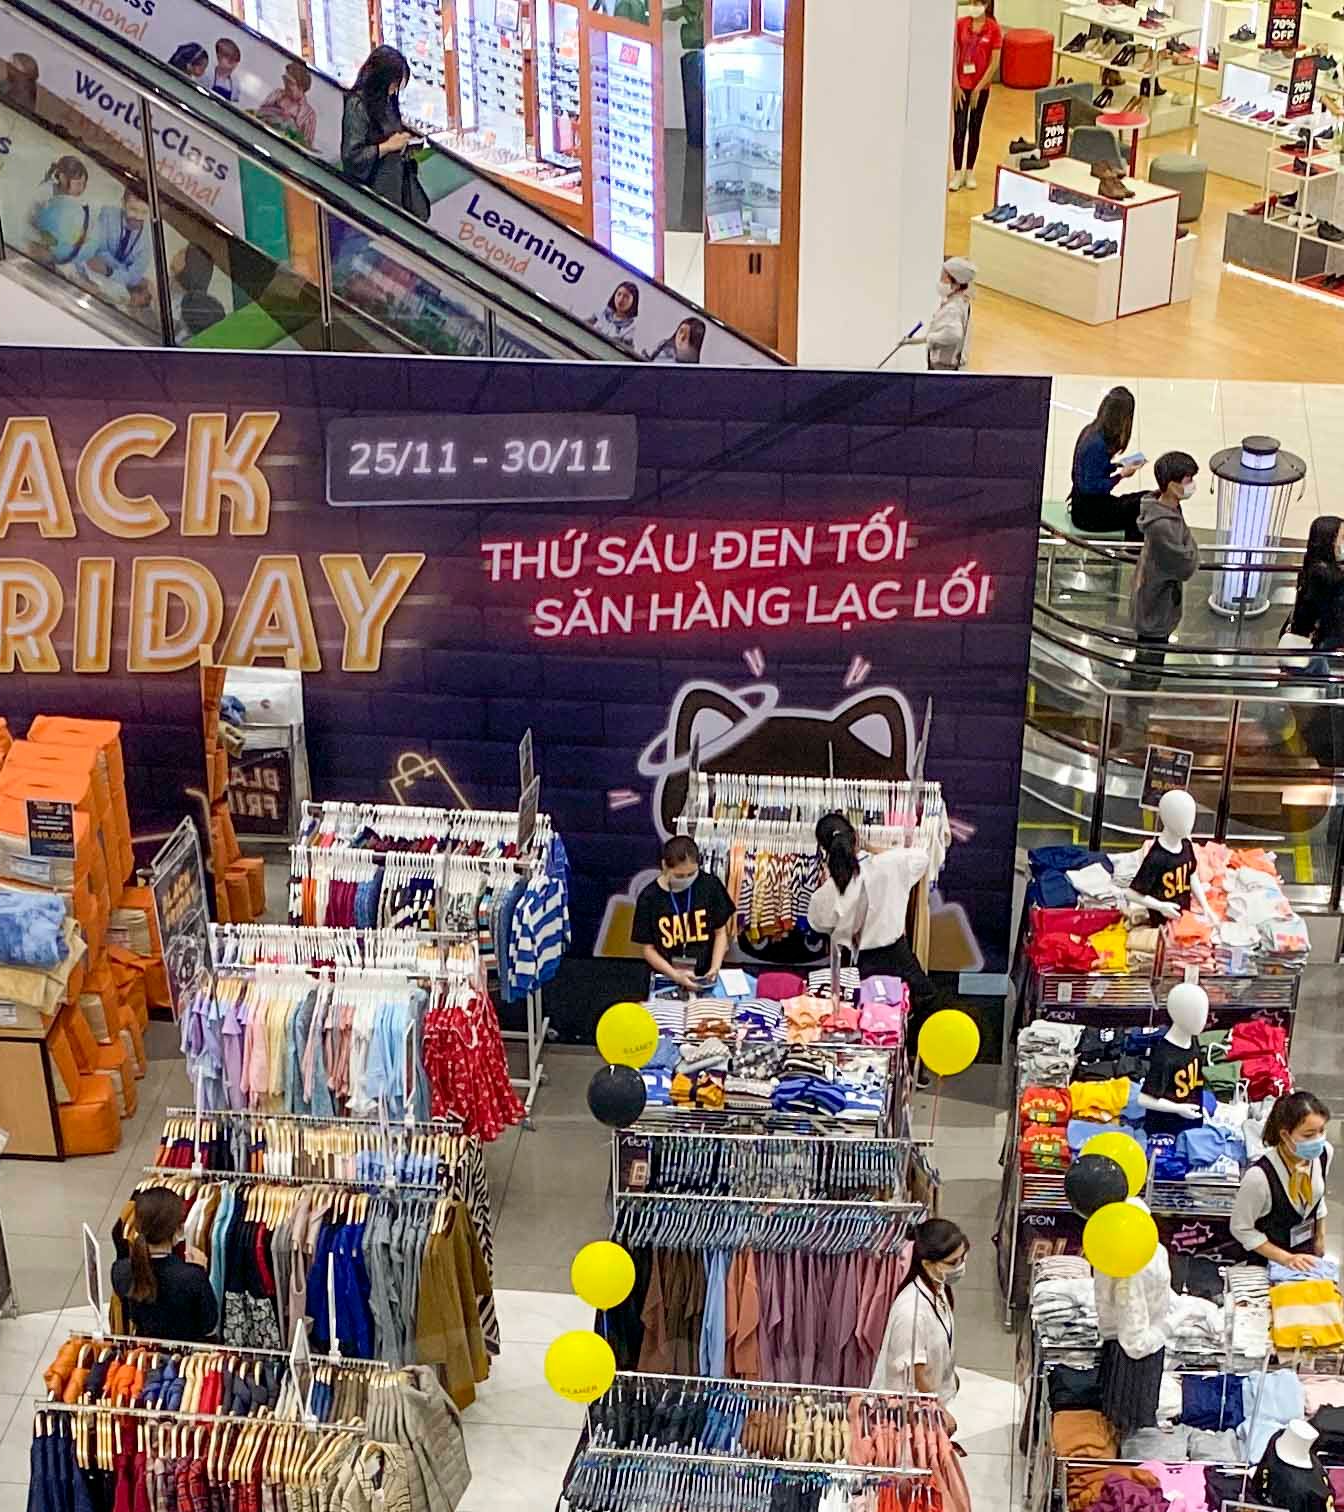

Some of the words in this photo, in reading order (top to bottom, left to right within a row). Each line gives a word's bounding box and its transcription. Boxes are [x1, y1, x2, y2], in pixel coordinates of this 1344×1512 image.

[1271, 30, 1295, 41] OFF
[1273, 18, 1296, 31] 70%
[1291, 93, 1311, 105] OFF
[1293, 82, 1313, 94] 70%
[73, 68, 230, 182] World-Class
[1043, 136, 1064, 149] OFF
[1045, 124, 1065, 138] 70%
[458, 220, 531, 276] Beyond
[465, 193, 586, 285] Learning
[348, 440, 457, 476] 25/11
[501, 437, 613, 475] 30/11
[482, 527, 587, 582] THỨ
[596, 523, 704, 574] SÁU
[709, 523, 812, 569] ĐEN
[819, 504, 911, 564] TỐI
[533, 588, 642, 638] SĂN
[647, 575, 792, 632] HÀNG
[805, 578, 901, 632] LẠC
[912, 560, 993, 618] LỐI
[1162, 861, 1193, 898] SAL
[658, 908, 709, 949] SALE
[1173, 1057, 1204, 1098] SAL
